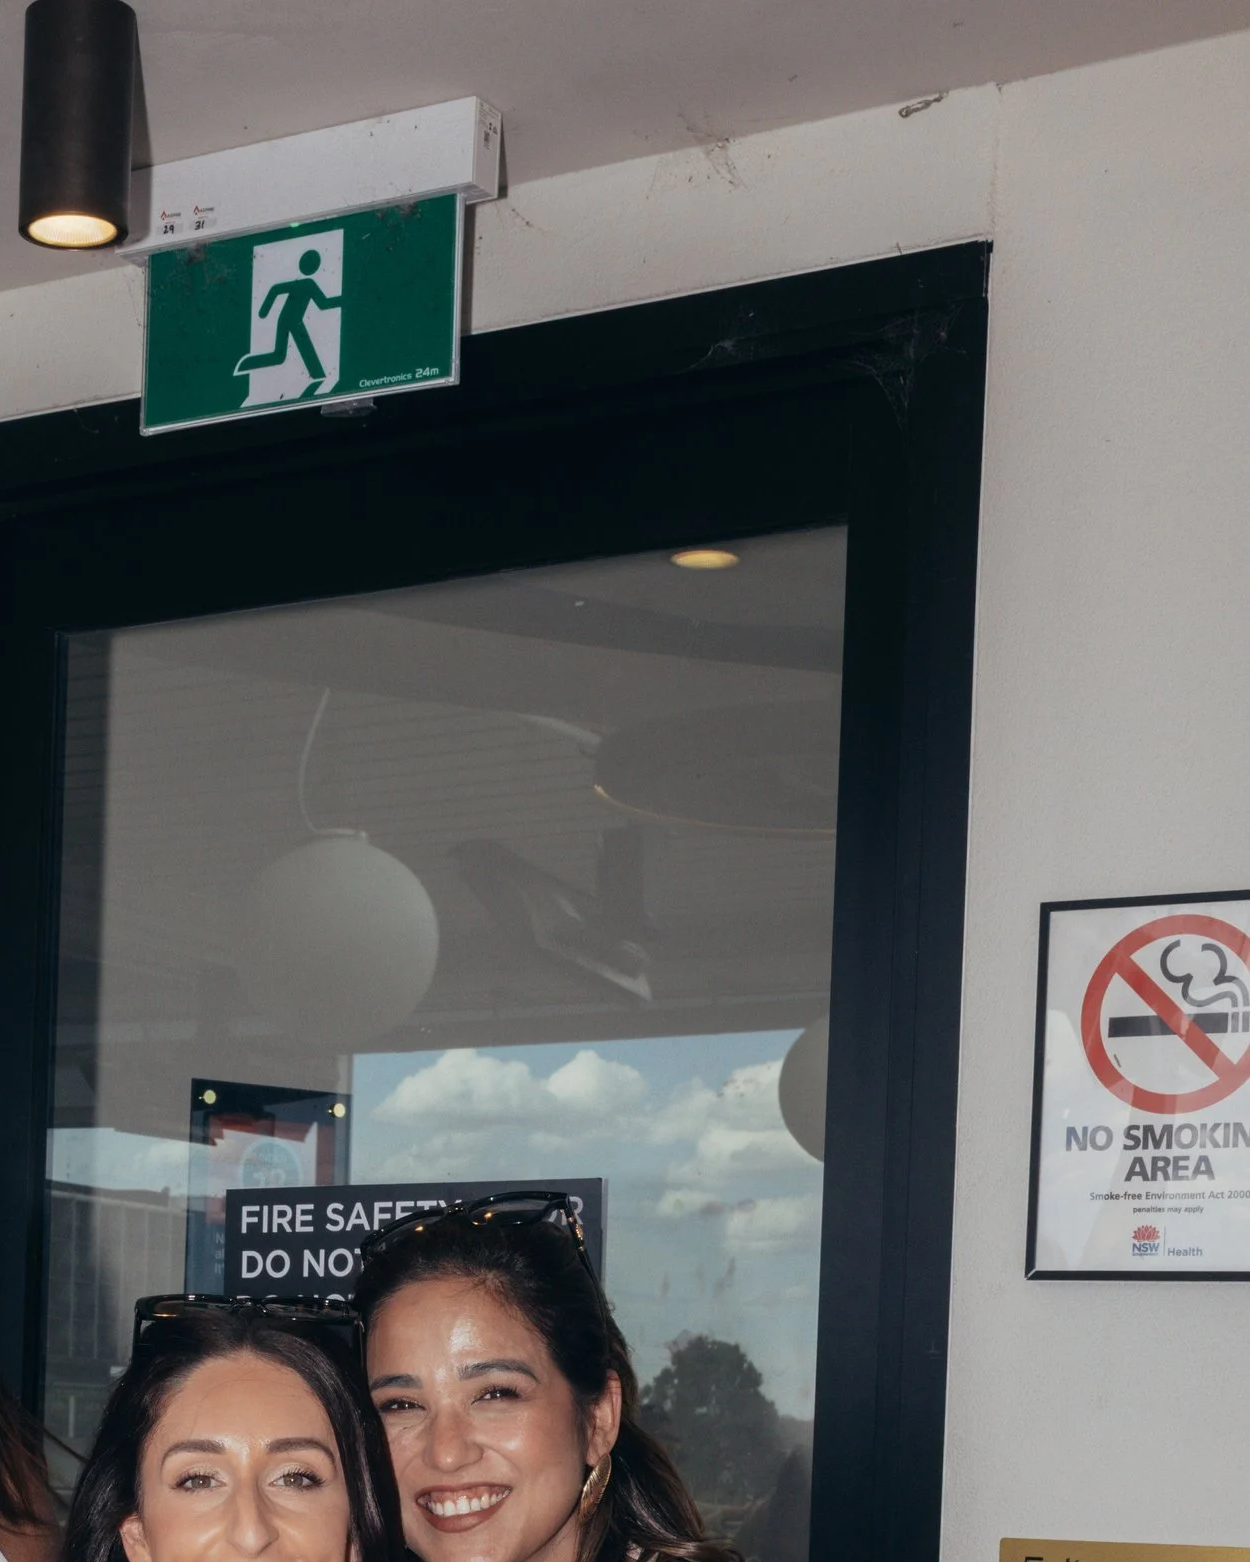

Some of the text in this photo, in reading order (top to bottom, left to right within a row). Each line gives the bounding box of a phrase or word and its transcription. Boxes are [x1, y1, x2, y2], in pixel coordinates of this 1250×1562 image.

[163, 224, 175, 235] 29
[358, 366, 439, 388] Clevertronics 24m
[1065, 1122, 1250, 1151] NO SMOKIN
[1123, 1155, 1216, 1182] AREA
[1089, 1189, 1250, 1201] Smoke-free Environment Act 2000
[241, 1199, 463, 1234] FIRE SAFE
[1132, 1205, 1166, 1214] penalties
[1184, 1205, 1205, 1214] apply
[1132, 1242, 1160, 1253] NSW
[1167, 1246, 1203, 1257] Health
[241, 1248, 362, 1279] DO NO
